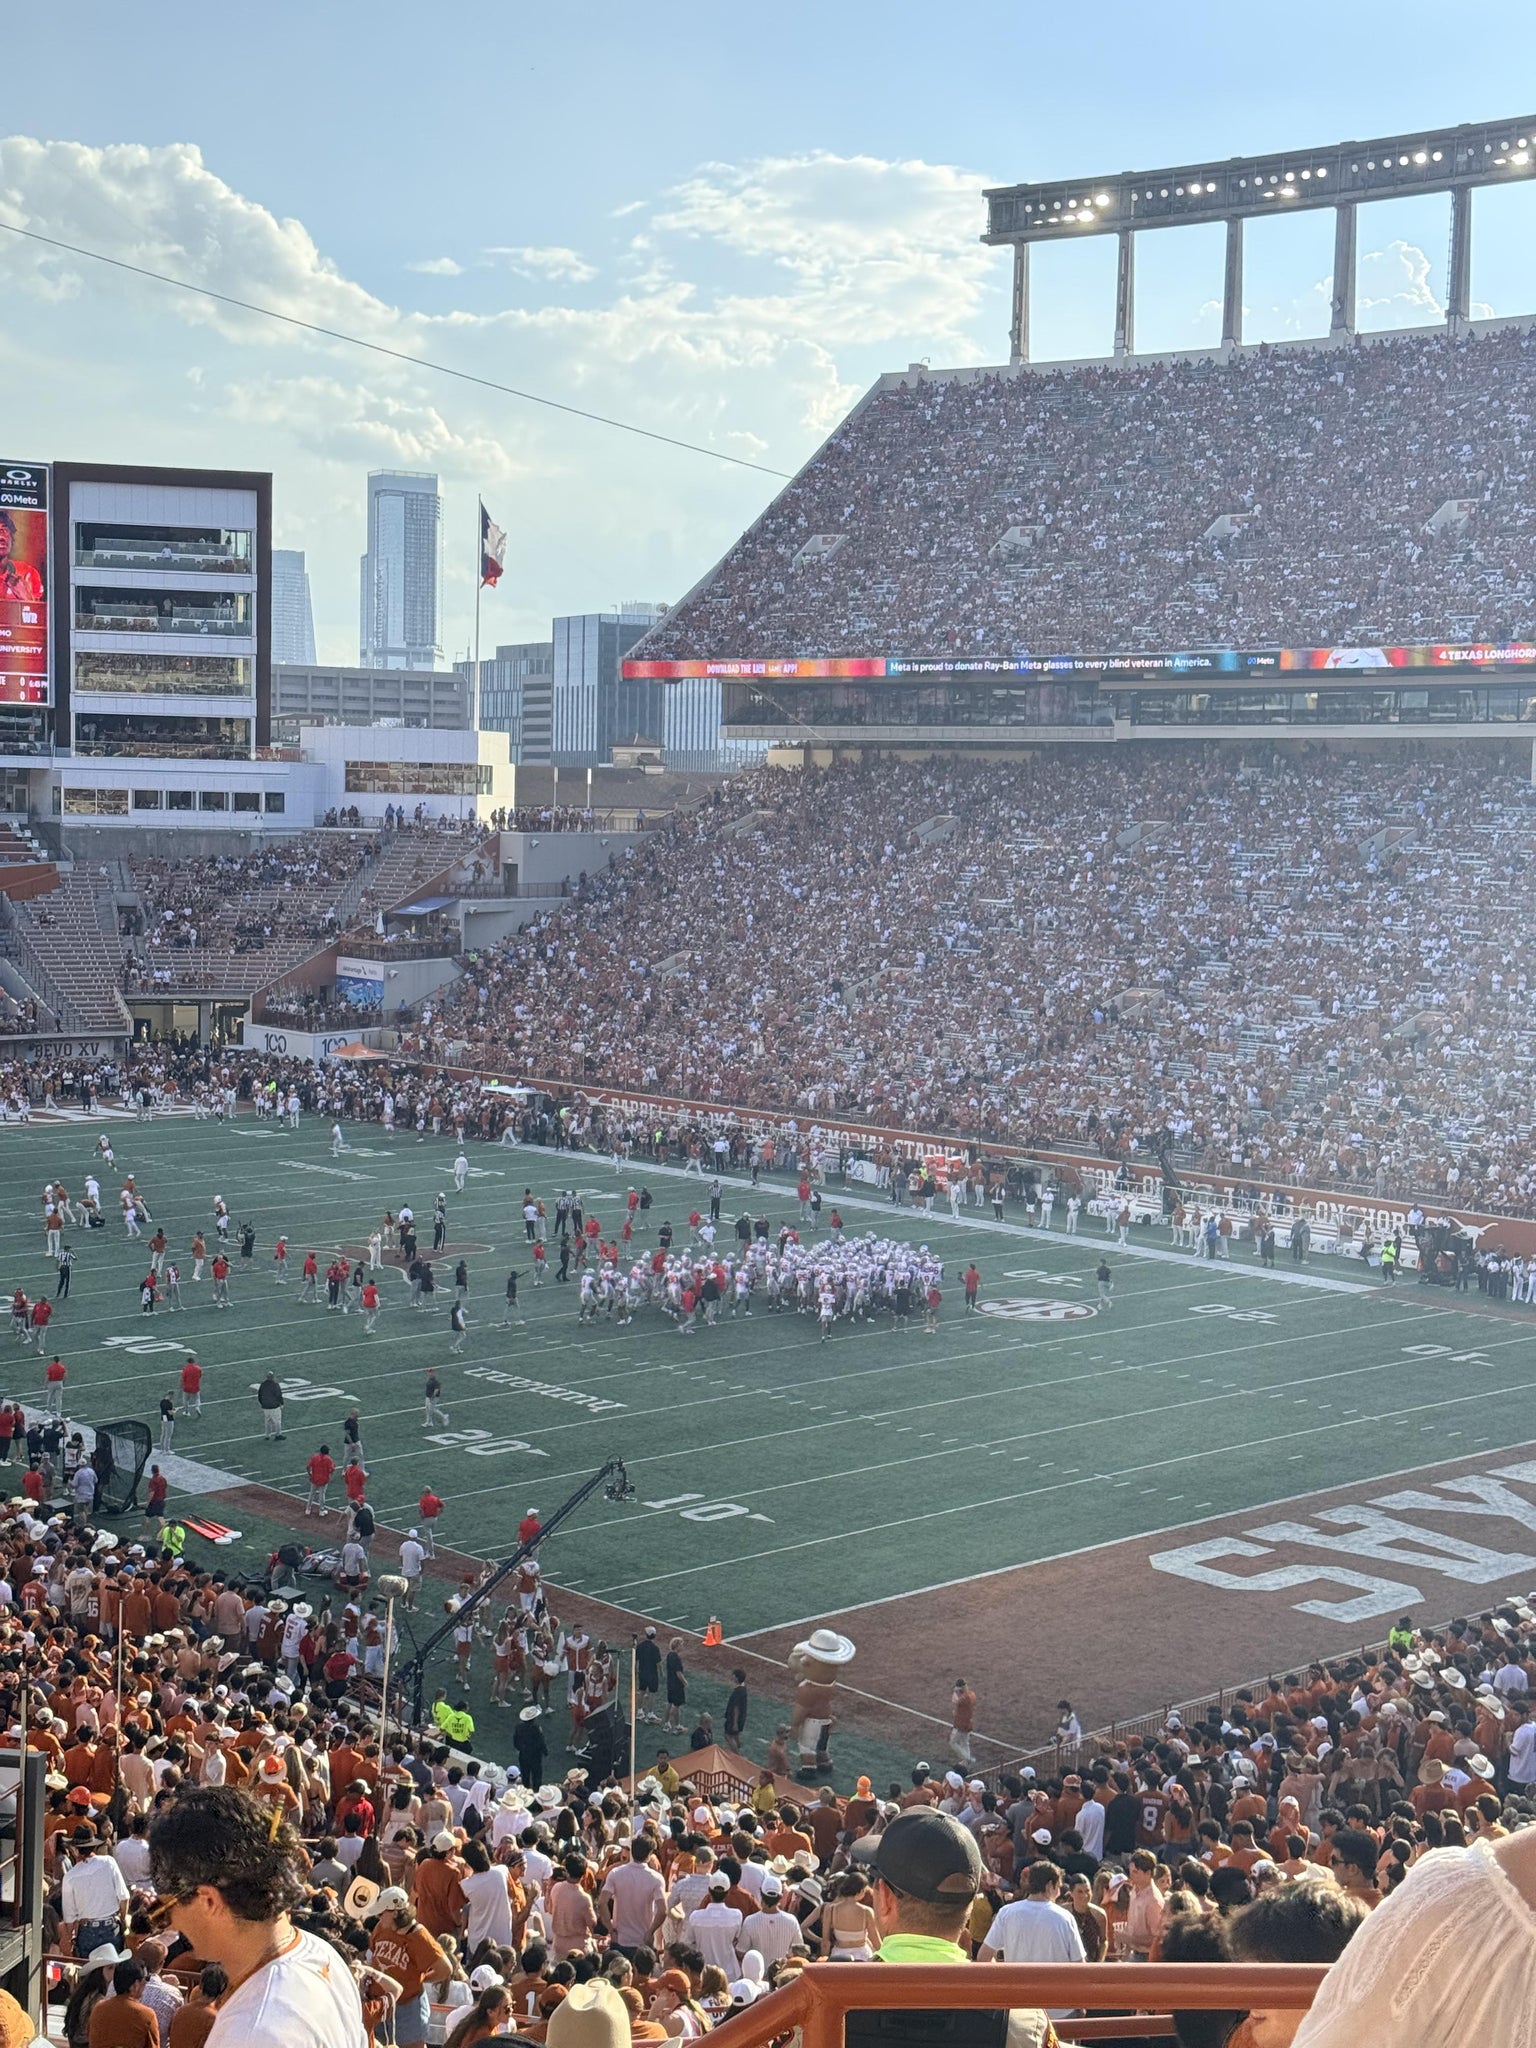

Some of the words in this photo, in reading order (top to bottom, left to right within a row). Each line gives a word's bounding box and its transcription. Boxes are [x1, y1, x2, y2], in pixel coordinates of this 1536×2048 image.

[14, 495, 38, 505] Meta
[1256, 656, 1275, 665] Meta
[1439, 651, 1446, 659] 4
[1448, 650, 1483, 660] TEXAS
[707, 664, 739, 674] DOWNLOAD
[741, 664, 752, 674] THE
[891, 662, 911, 671] Meta
[912, 662, 919, 671] is
[920, 662, 943, 673] proud
[944, 661, 953, 671] to
[955, 661, 982, 671] donate
[984, 661, 1019, 673] Ray-Ban
[1021, 660, 1041, 670] Meta
[1043, 660, 1073, 671] glasses
[1074, 660, 1083, 669] to
[1085, 660, 1107, 670] every
[1109, 658, 1129, 668] blind
[1131, 659, 1163, 668] veteran
[1165, 658, 1173, 667] in
[1173, 657, 1212, 667] America.
[20, 677, 25, 686] 0
[20, 691, 25, 700] 0
[34, 1043, 72, 1058] BEVO
[78, 1043, 100, 1056] XV
[264, 1033, 287, 1053] 100
[611, 1097, 673, 1121] DARREL
[811, 1126, 885, 1151] EMORIAL
[101, 1335, 187, 1354] 40
[423, 1429, 533, 1456] 20
[642, 1493, 750, 1522] 10
[87, 1601, 98, 1617] 16
[259, 1623, 266, 1639] 3
[286, 1624, 294, 1639] 5
[1143, 1805, 1158, 1831] 8
[373, 1940, 410, 1970] TEXAS
[525, 1990, 536, 2016] 1
